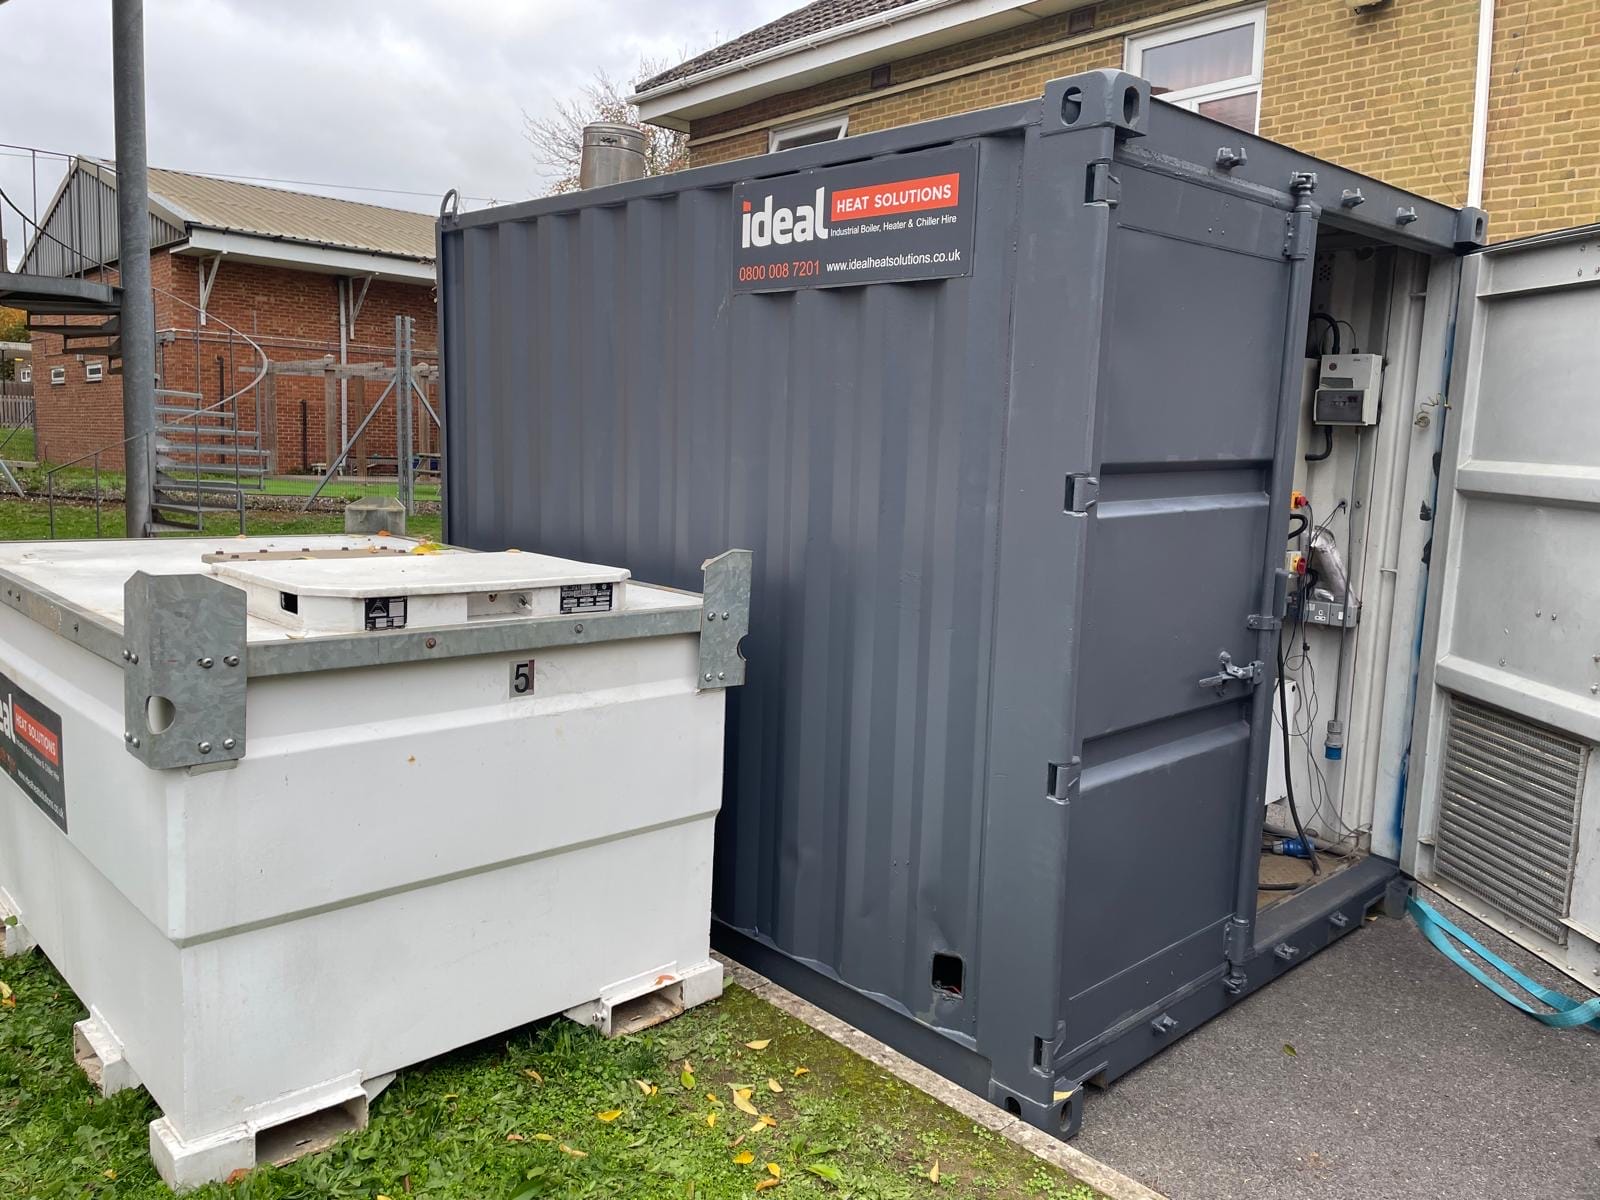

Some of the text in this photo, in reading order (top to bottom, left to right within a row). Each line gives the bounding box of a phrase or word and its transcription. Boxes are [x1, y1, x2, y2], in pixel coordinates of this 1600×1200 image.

[836, 184, 952, 213] HEAT SOLUTIONS
[742, 186, 829, 249] ideal
[830, 214, 957, 237] Industrial Boiler, Heater & Chiller Hire
[739, 260, 820, 282] 0800 008 7201
[825, 249, 961, 273] www.idealheatsolutions.co.uk
[514, 663, 530, 694] 5
[15, 711, 57, 756] HEAT SOLUTIONS
